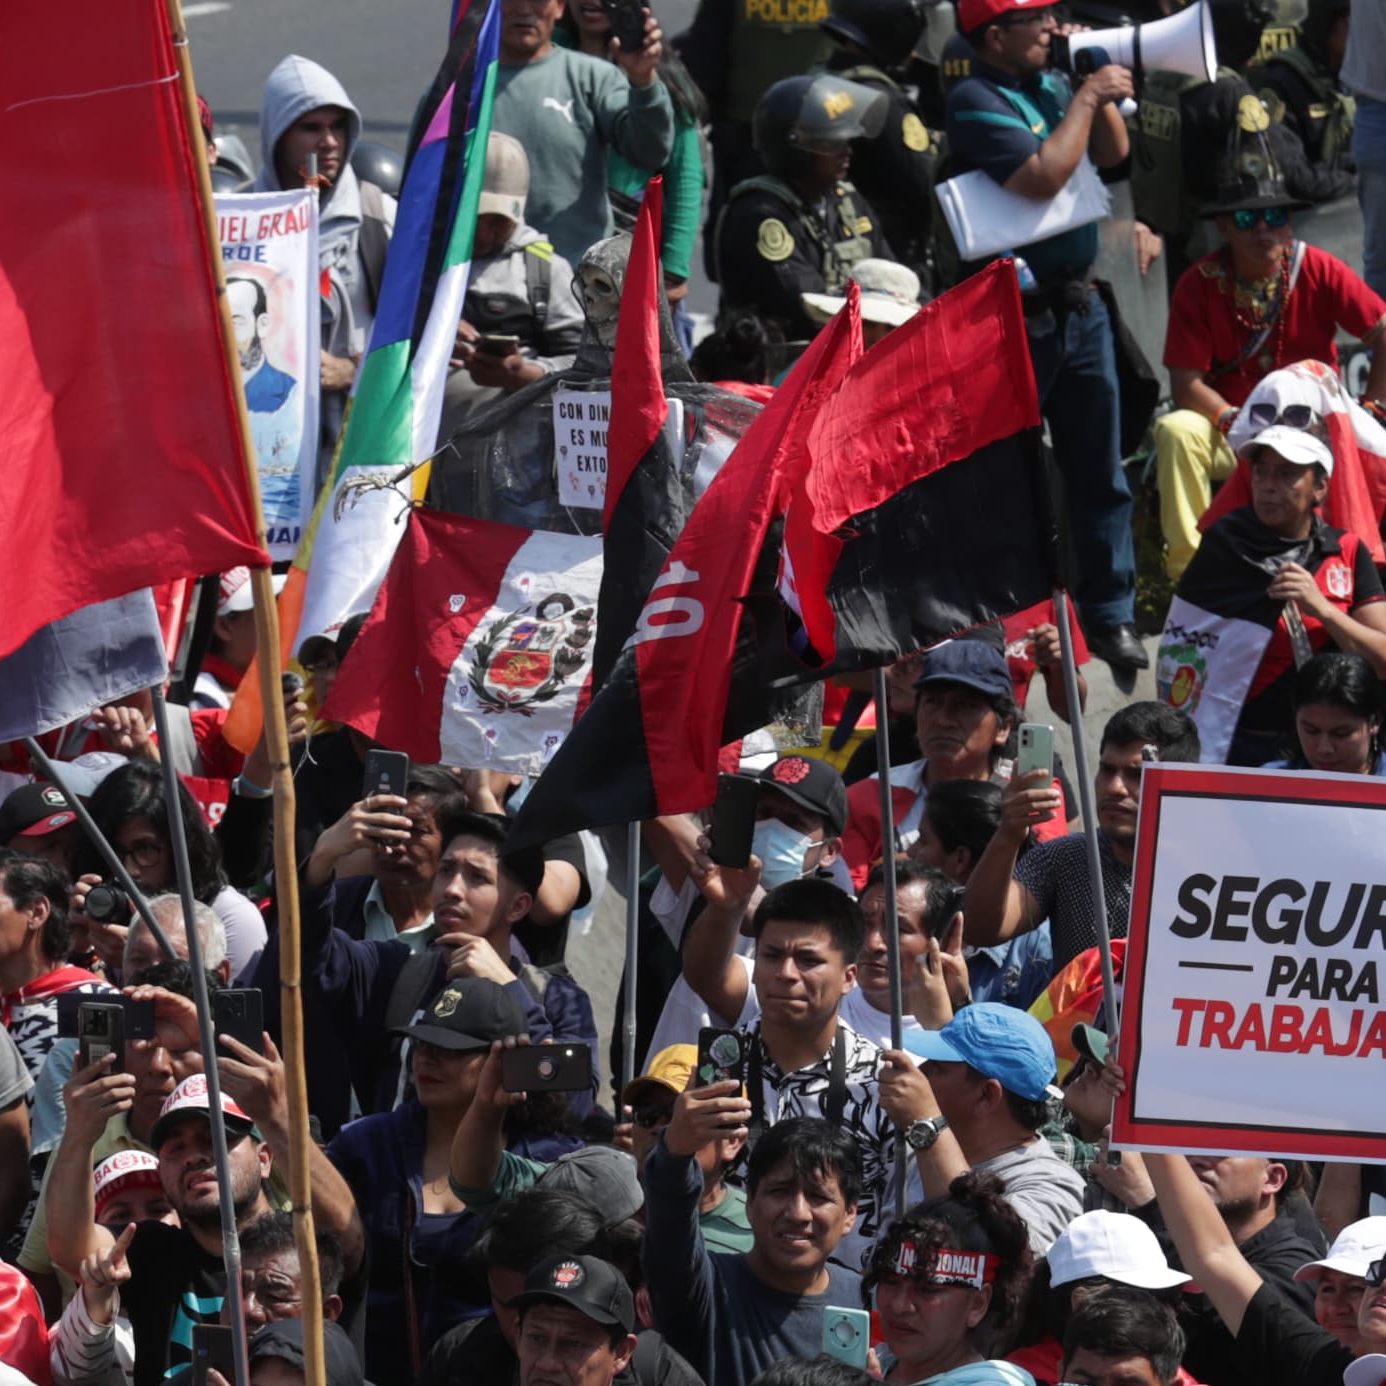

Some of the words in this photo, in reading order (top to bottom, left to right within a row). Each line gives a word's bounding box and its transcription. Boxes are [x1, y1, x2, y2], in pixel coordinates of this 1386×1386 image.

[559, 403, 584, 420] CON
[571, 429, 586, 445] ES
[1266, 955, 1378, 1002] PARA
